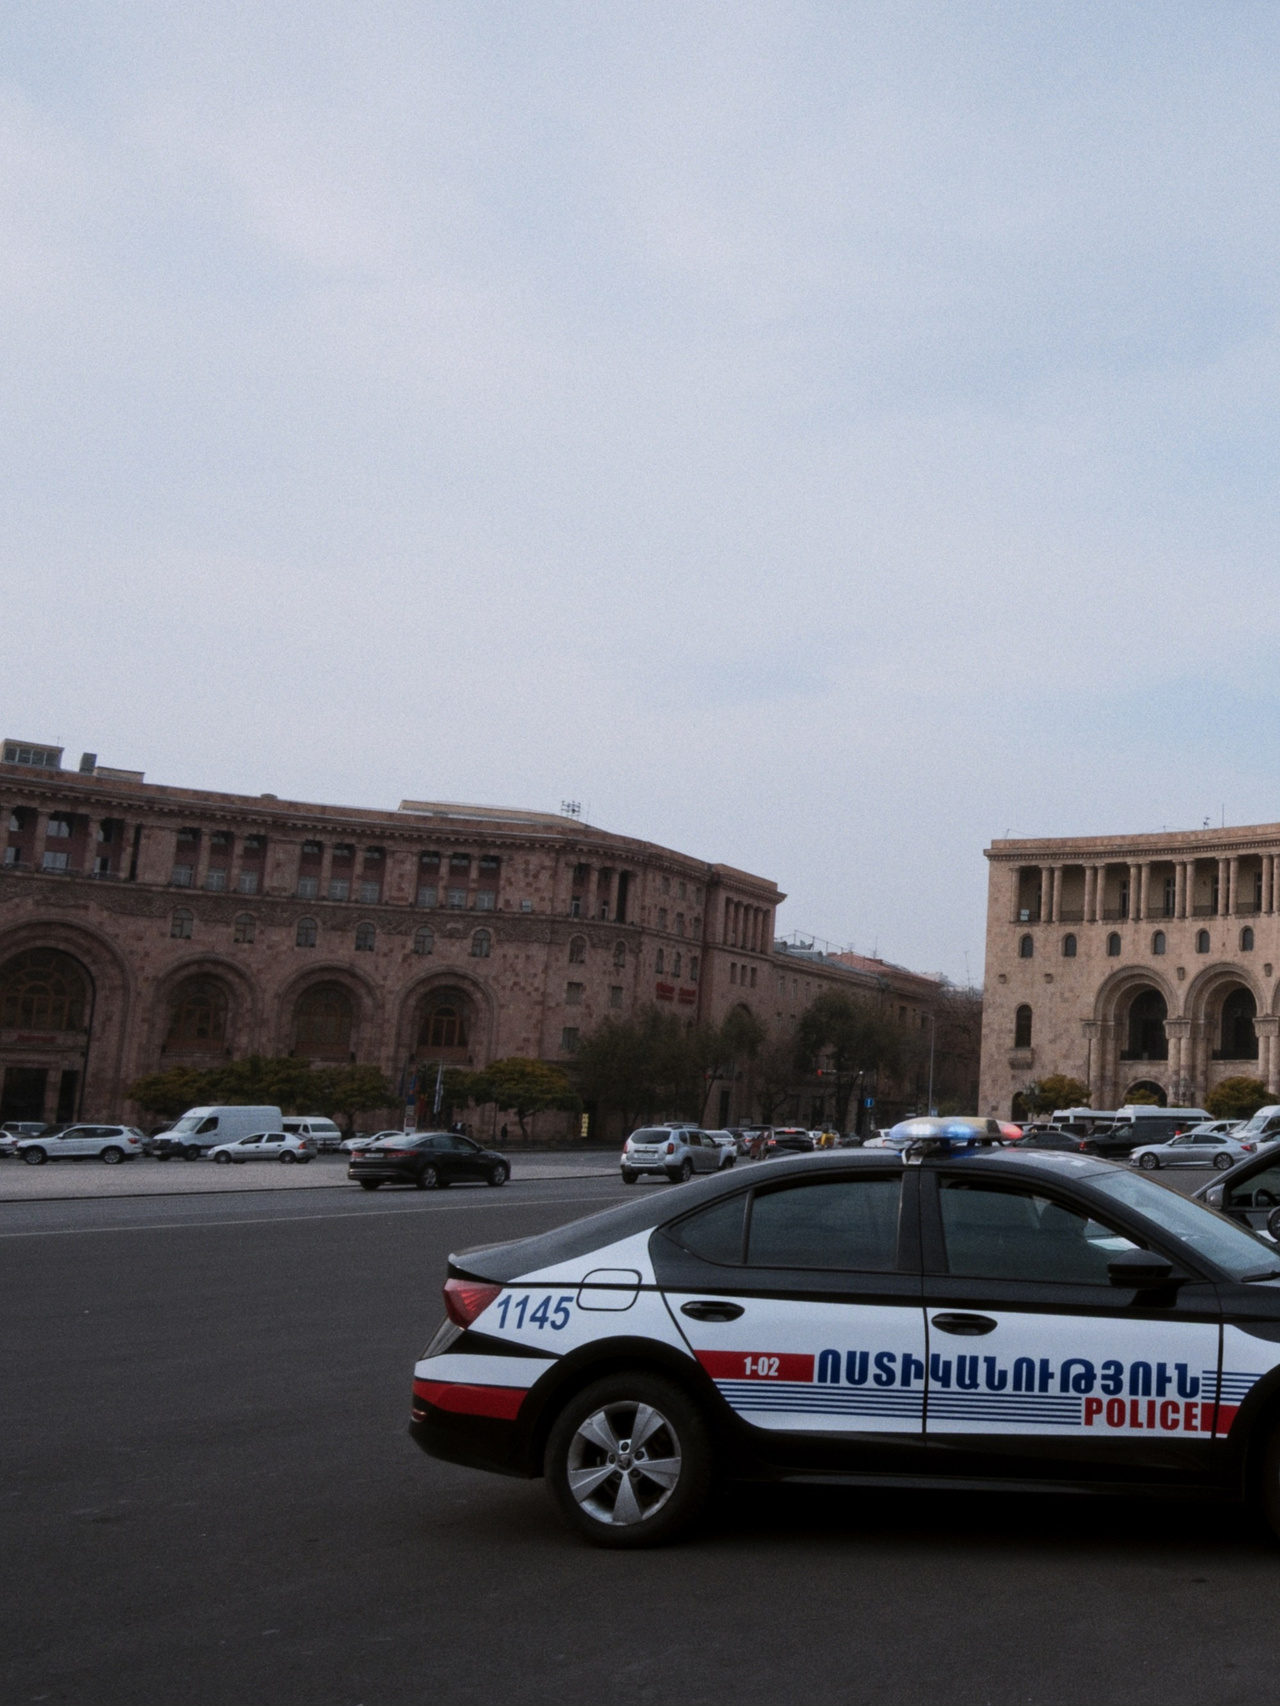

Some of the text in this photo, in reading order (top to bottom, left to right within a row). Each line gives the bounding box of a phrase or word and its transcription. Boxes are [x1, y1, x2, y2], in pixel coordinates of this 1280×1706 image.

[497, 1294, 574, 1331] 1145
[743, 1356, 779, 1377] 1-02
[817, 1348, 1201, 1399] ՈՍՏԻԿԱՆՈՒԹՅՈՒՆ
[1083, 1397, 1199, 1431] POLICE
